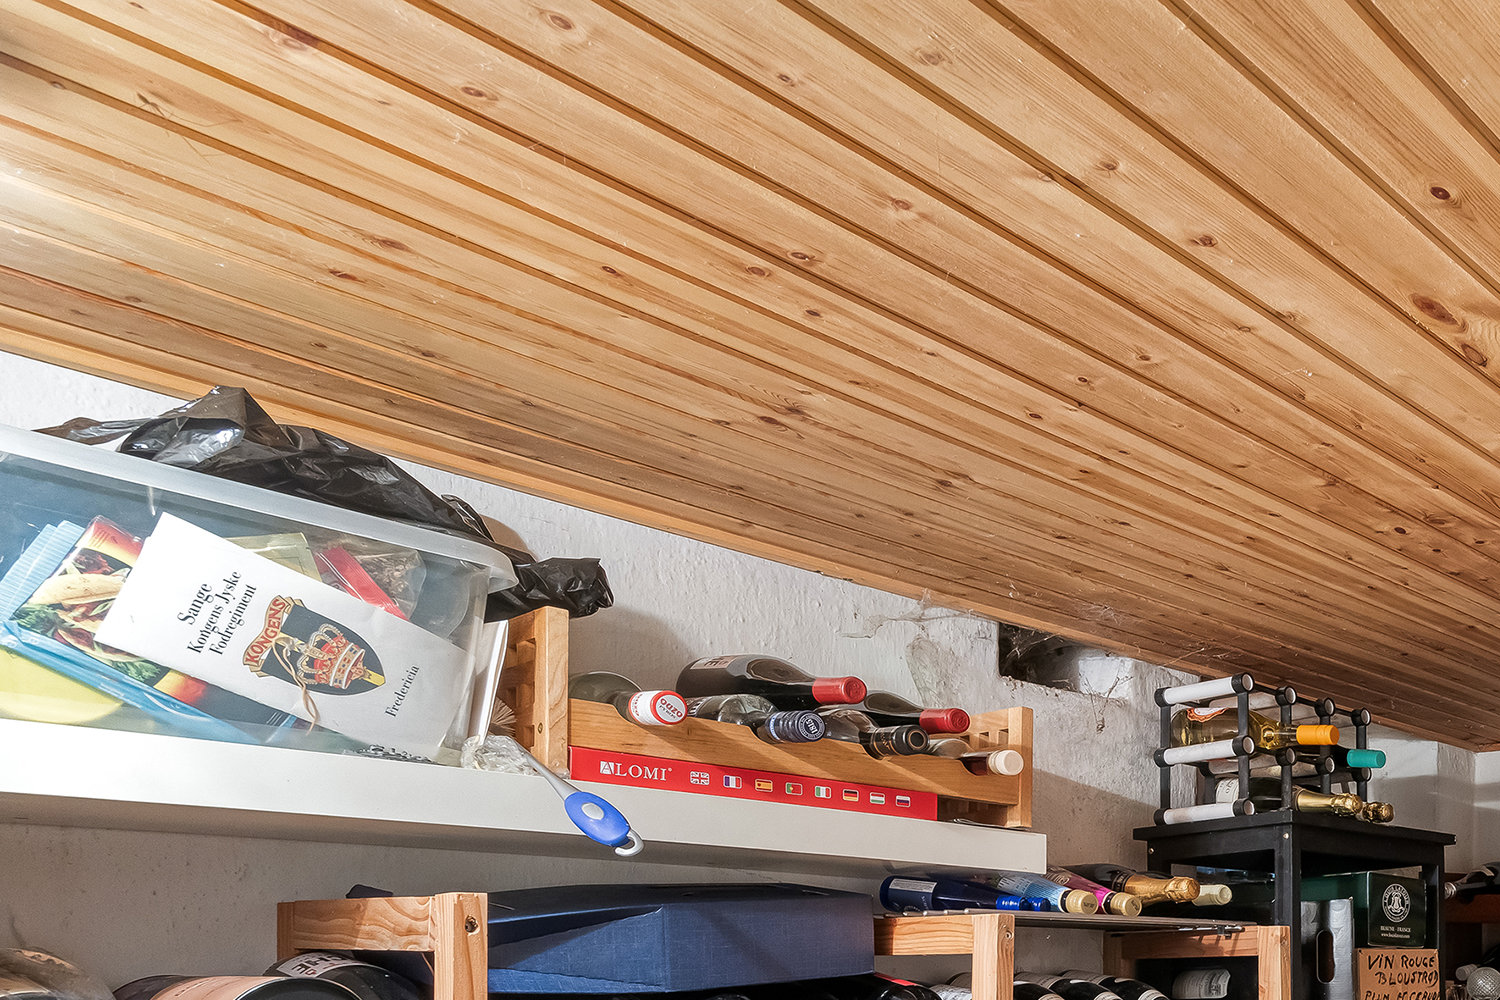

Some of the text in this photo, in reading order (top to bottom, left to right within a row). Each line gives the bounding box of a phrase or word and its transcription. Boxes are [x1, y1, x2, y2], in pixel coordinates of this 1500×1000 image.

[176, 581, 213, 626] Sange
[186, 569, 243, 655] Kongens Jyske
[208, 584, 257, 656] Fodregiment
[243, 597, 287, 666] KONGENS
[385, 664, 421, 719] Fredericia
[1400, 953, 1435, 969] ROUGE
